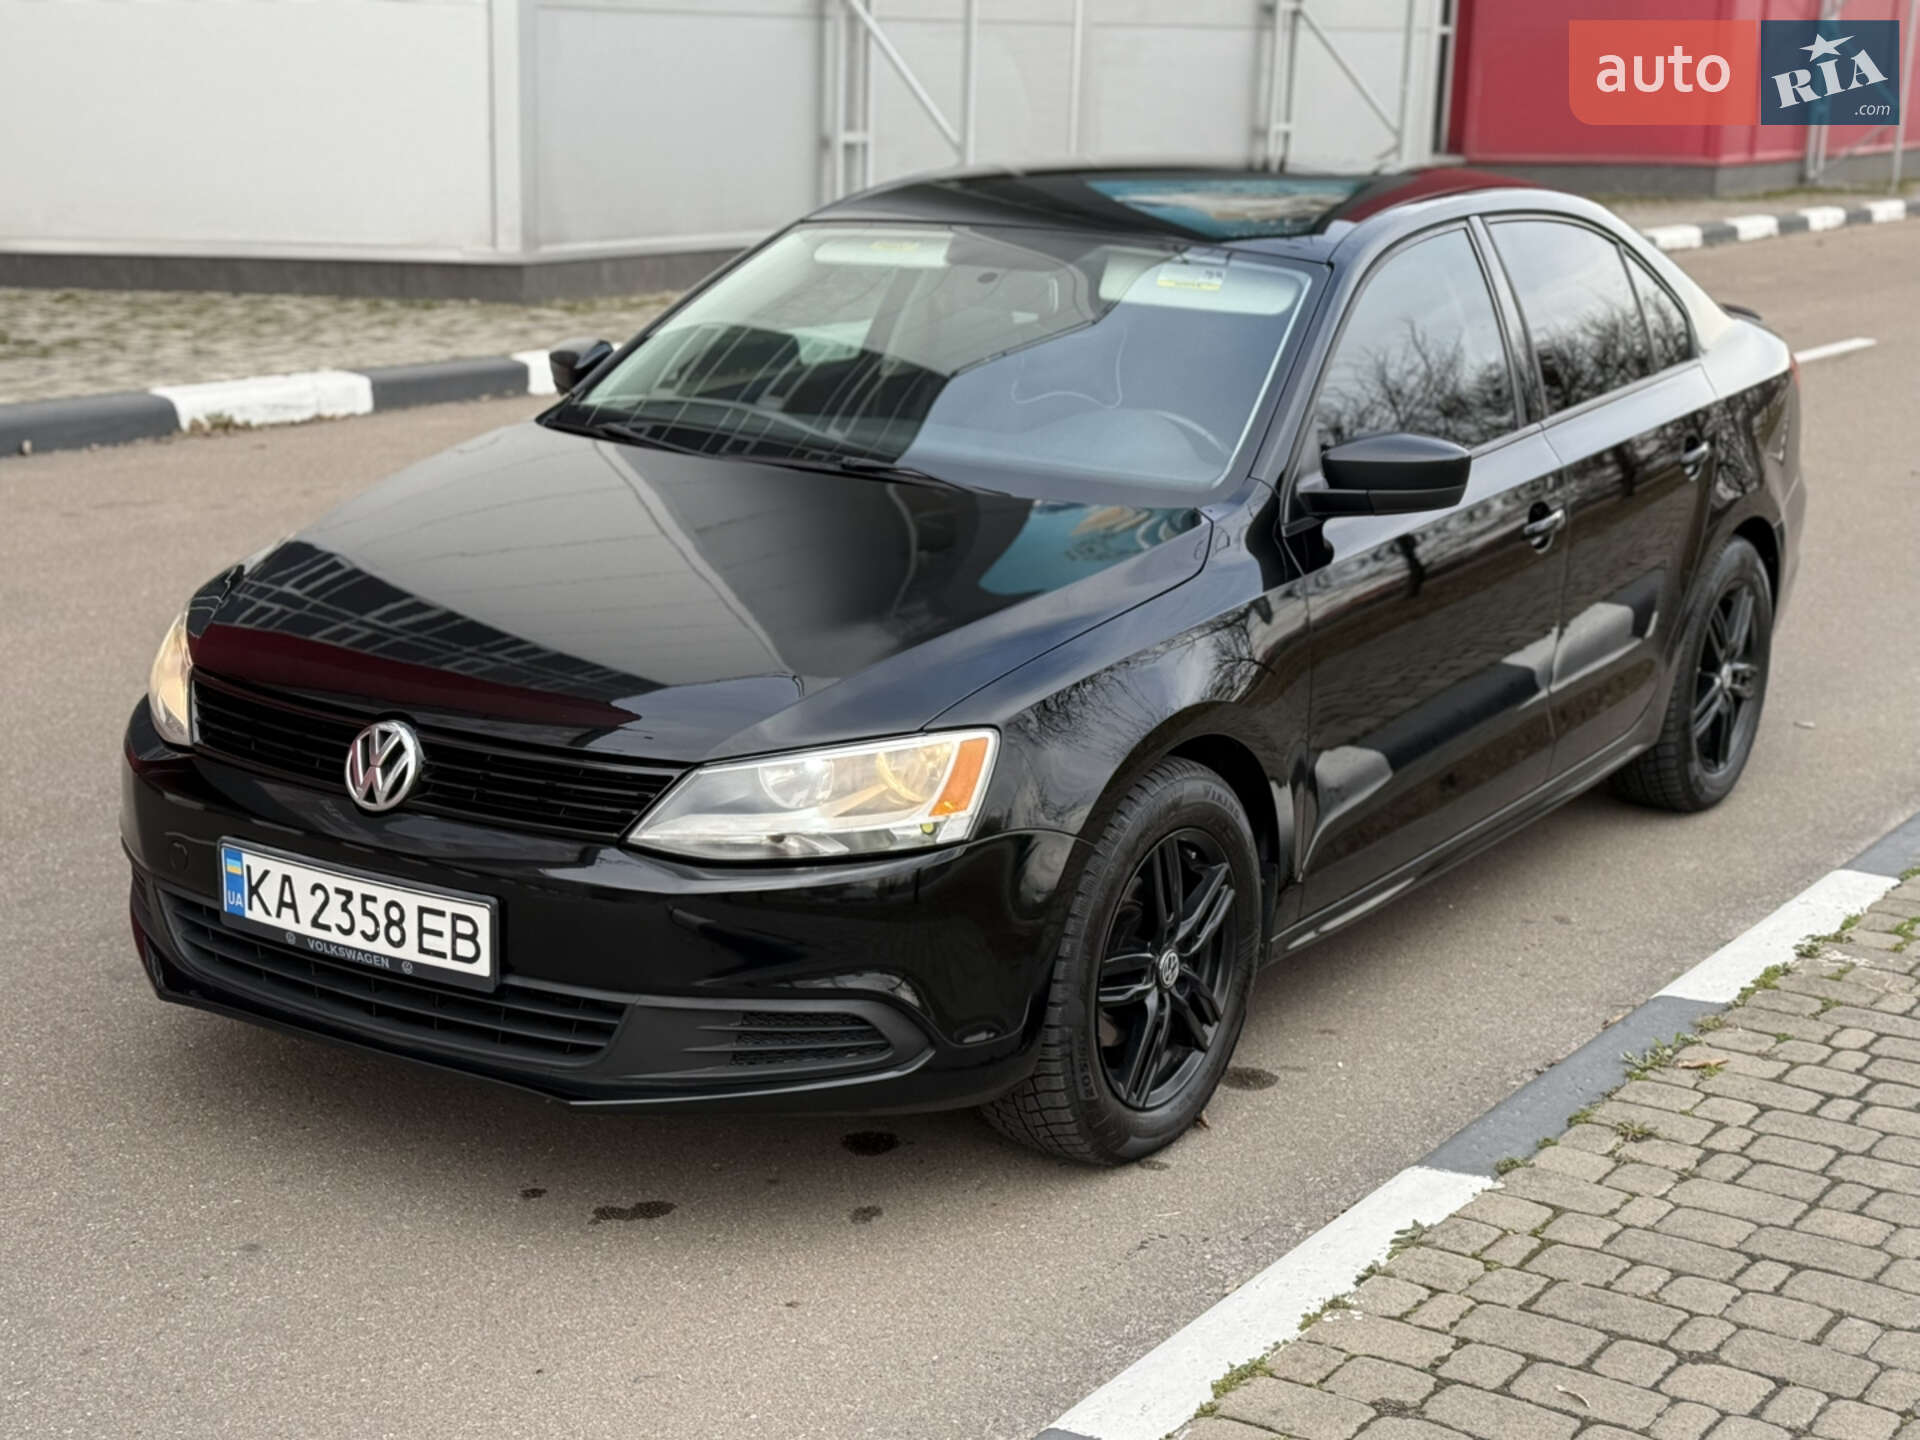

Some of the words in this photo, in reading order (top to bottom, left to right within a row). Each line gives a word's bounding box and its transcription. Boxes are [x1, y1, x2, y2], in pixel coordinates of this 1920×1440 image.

[227, 889, 244, 908] UA
[246, 864, 300, 924] KA
[310, 882, 406, 948] 2358
[417, 905, 481, 964] EB
[307, 938, 390, 968] VOLKSWAGEN
